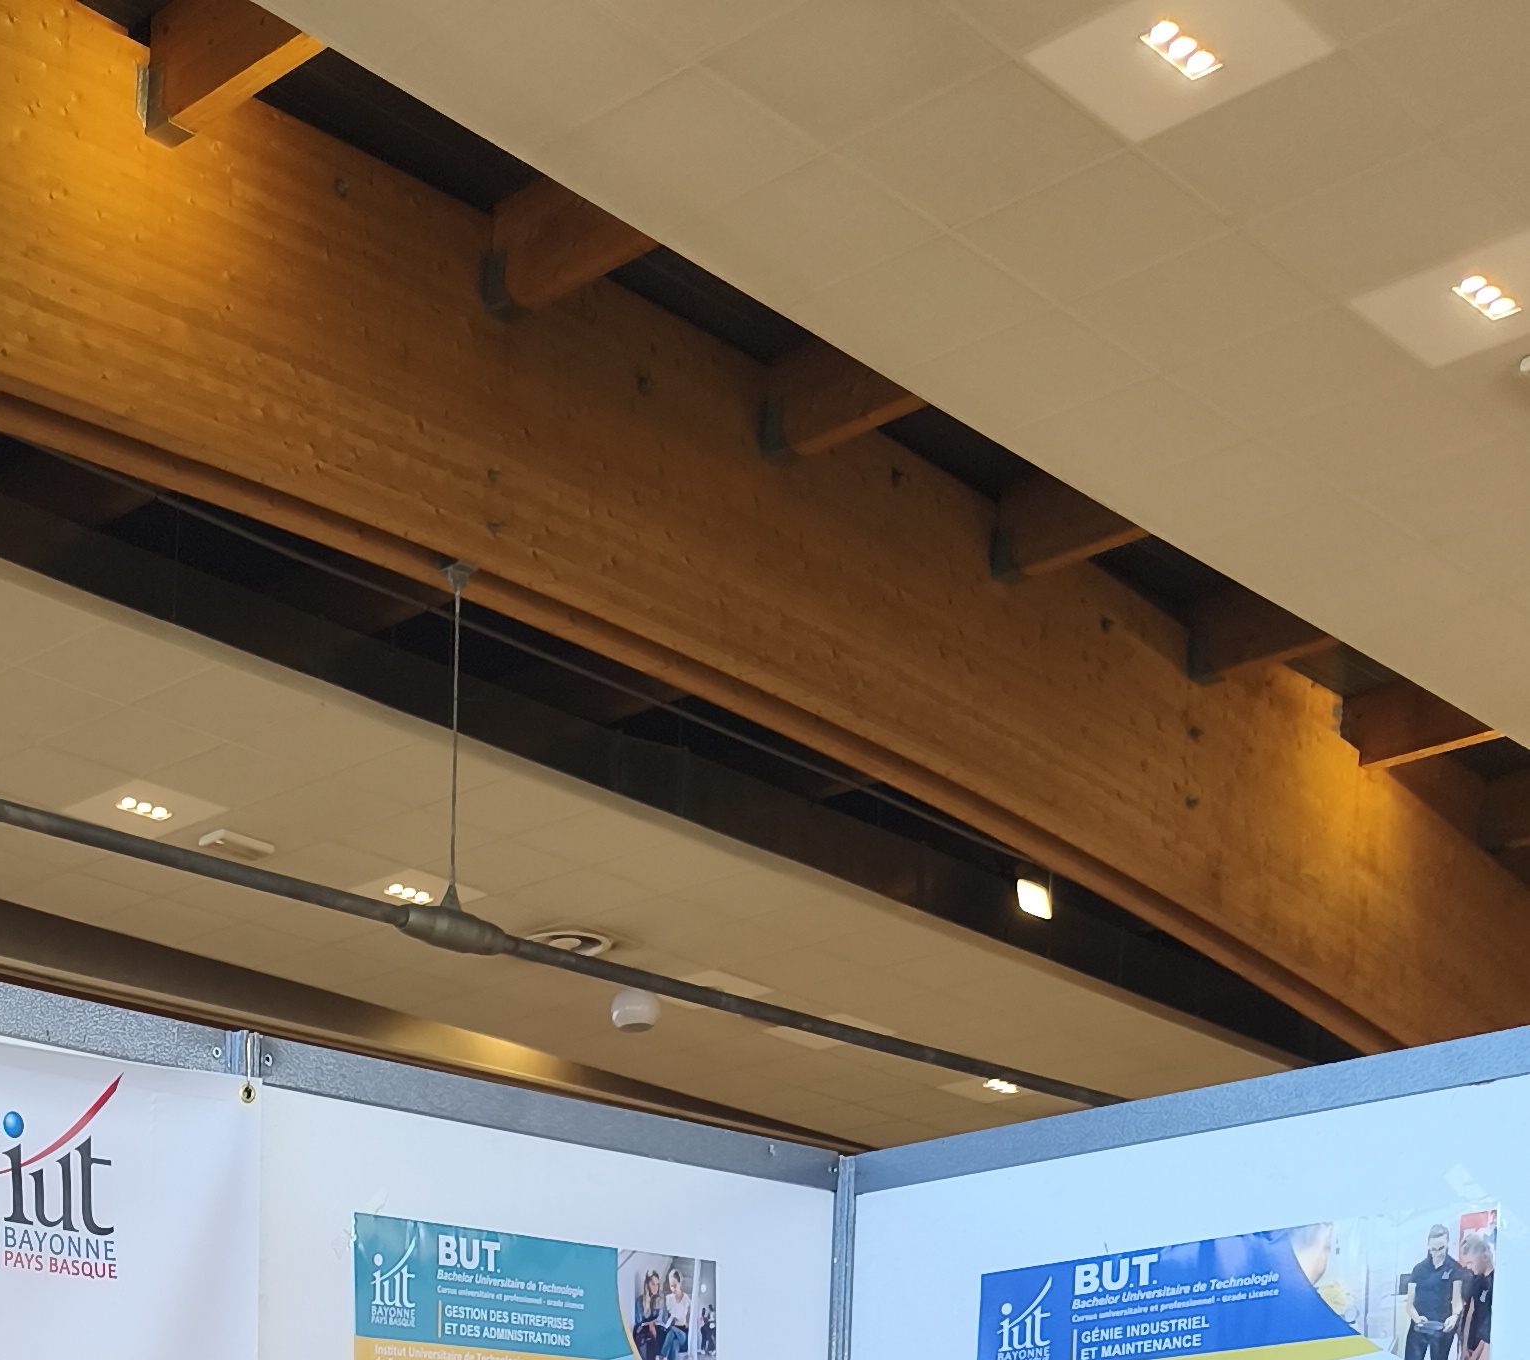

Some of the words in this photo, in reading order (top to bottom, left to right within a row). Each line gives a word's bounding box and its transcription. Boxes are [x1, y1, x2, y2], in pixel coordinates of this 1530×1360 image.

[3, 1226, 116, 1262] BAYONNE
[438, 1234, 501, 1273] B.U.T.
[4, 1250, 44, 1272] PAYS
[48, 1256, 119, 1280] BASQUE
[1074, 1253, 1159, 1296] B.U.T.
[437, 1269, 473, 1284] Bachelor
[475, 1273, 525, 1290] Universitaire
[526, 1280, 537, 1291] de
[538, 1280, 585, 1299] Technologie
[1072, 1293, 1121, 1311] Bachelor
[1121, 1282, 1190, 1304] Universitaire
[1192, 1280, 1207, 1294] de
[1209, 1270, 1280, 1294] Technologie
[371, 1305, 416, 1319] BAYONNE
[445, 1304, 488, 1322] GESTION
[489, 1309, 509, 1324] DES
[510, 1311, 574, 1331] ENTREPRISES
[445, 1323, 457, 1336] ET
[459, 1325, 480, 1338] DES
[482, 1326, 571, 1347] ADMINISTRATIONS
[1081, 1326, 1123, 1345] GÉNIE
[1126, 1315, 1210, 1339] INDUSTRIEL
[1100, 1333, 1202, 1359] MAINTENANCE
